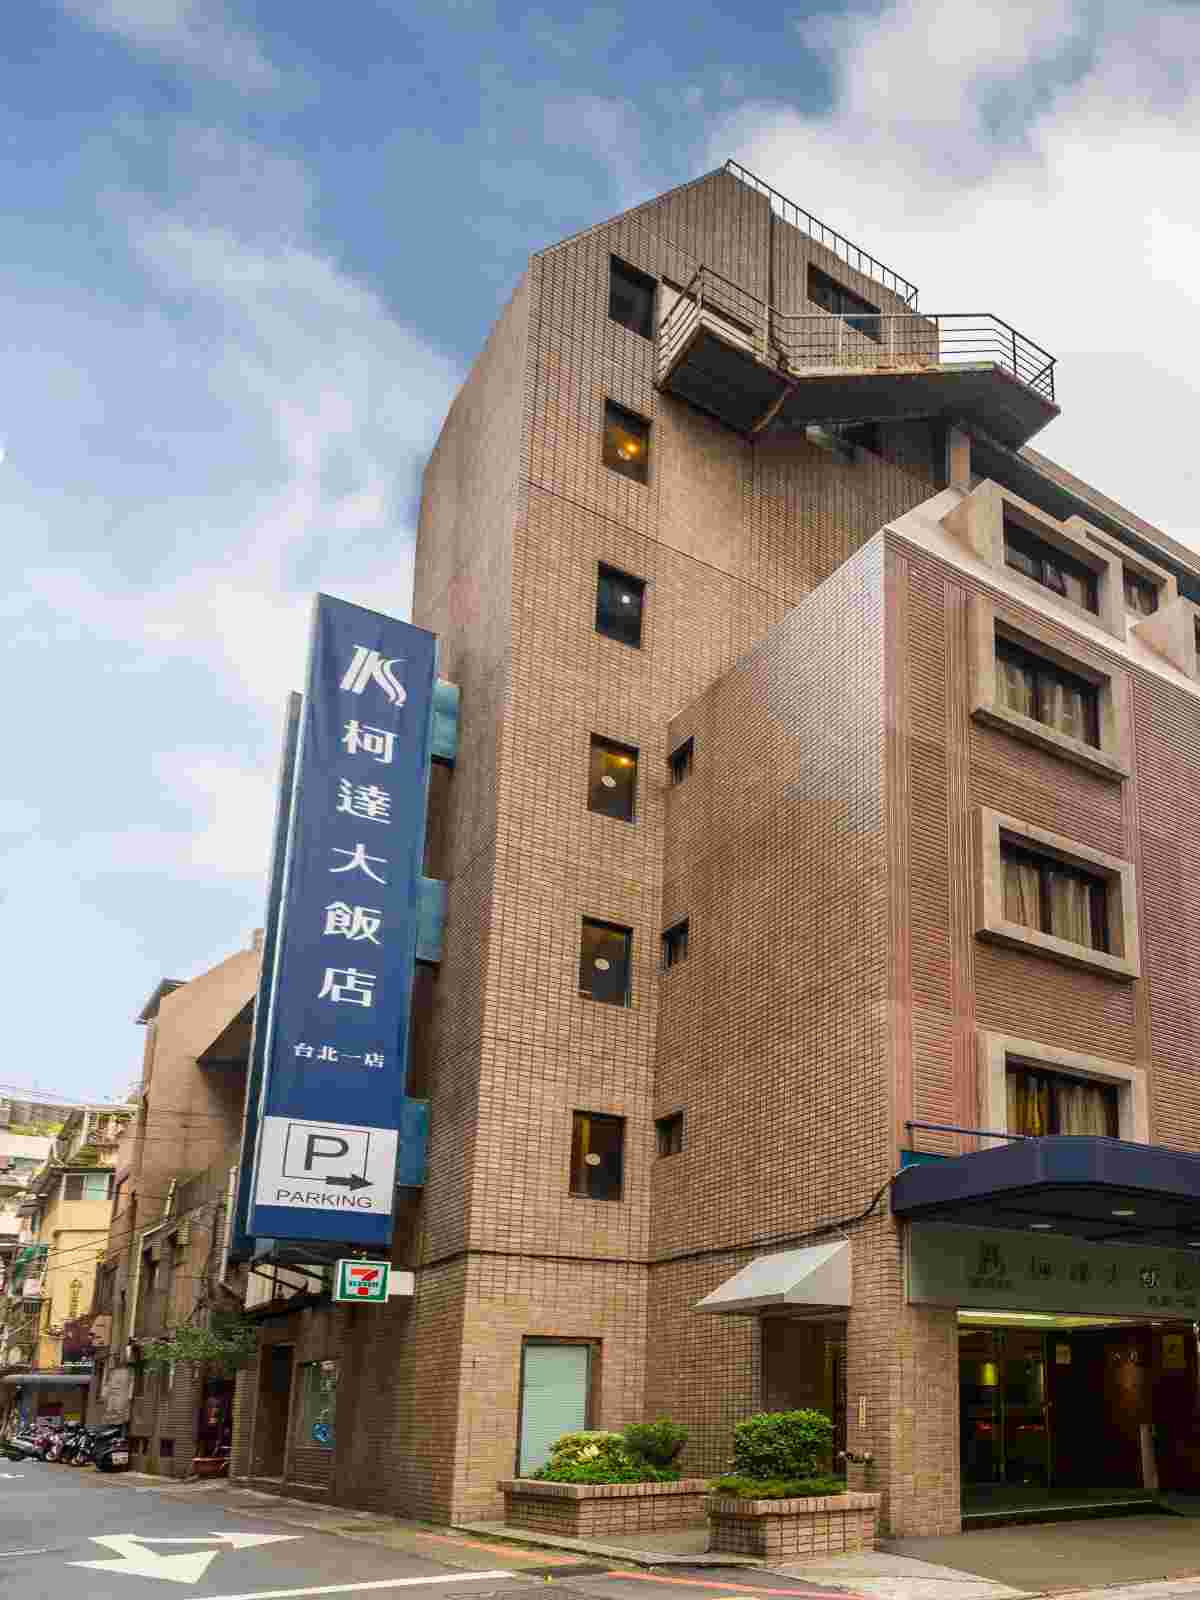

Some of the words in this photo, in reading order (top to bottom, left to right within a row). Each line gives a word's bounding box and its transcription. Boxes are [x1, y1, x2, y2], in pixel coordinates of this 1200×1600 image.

[318, 719, 399, 1008] 柯達大飯店
[293, 1042, 385, 1069] 台北一店
[304, 1134, 350, 1172] P
[276, 1189, 373, 1209] PARKING
